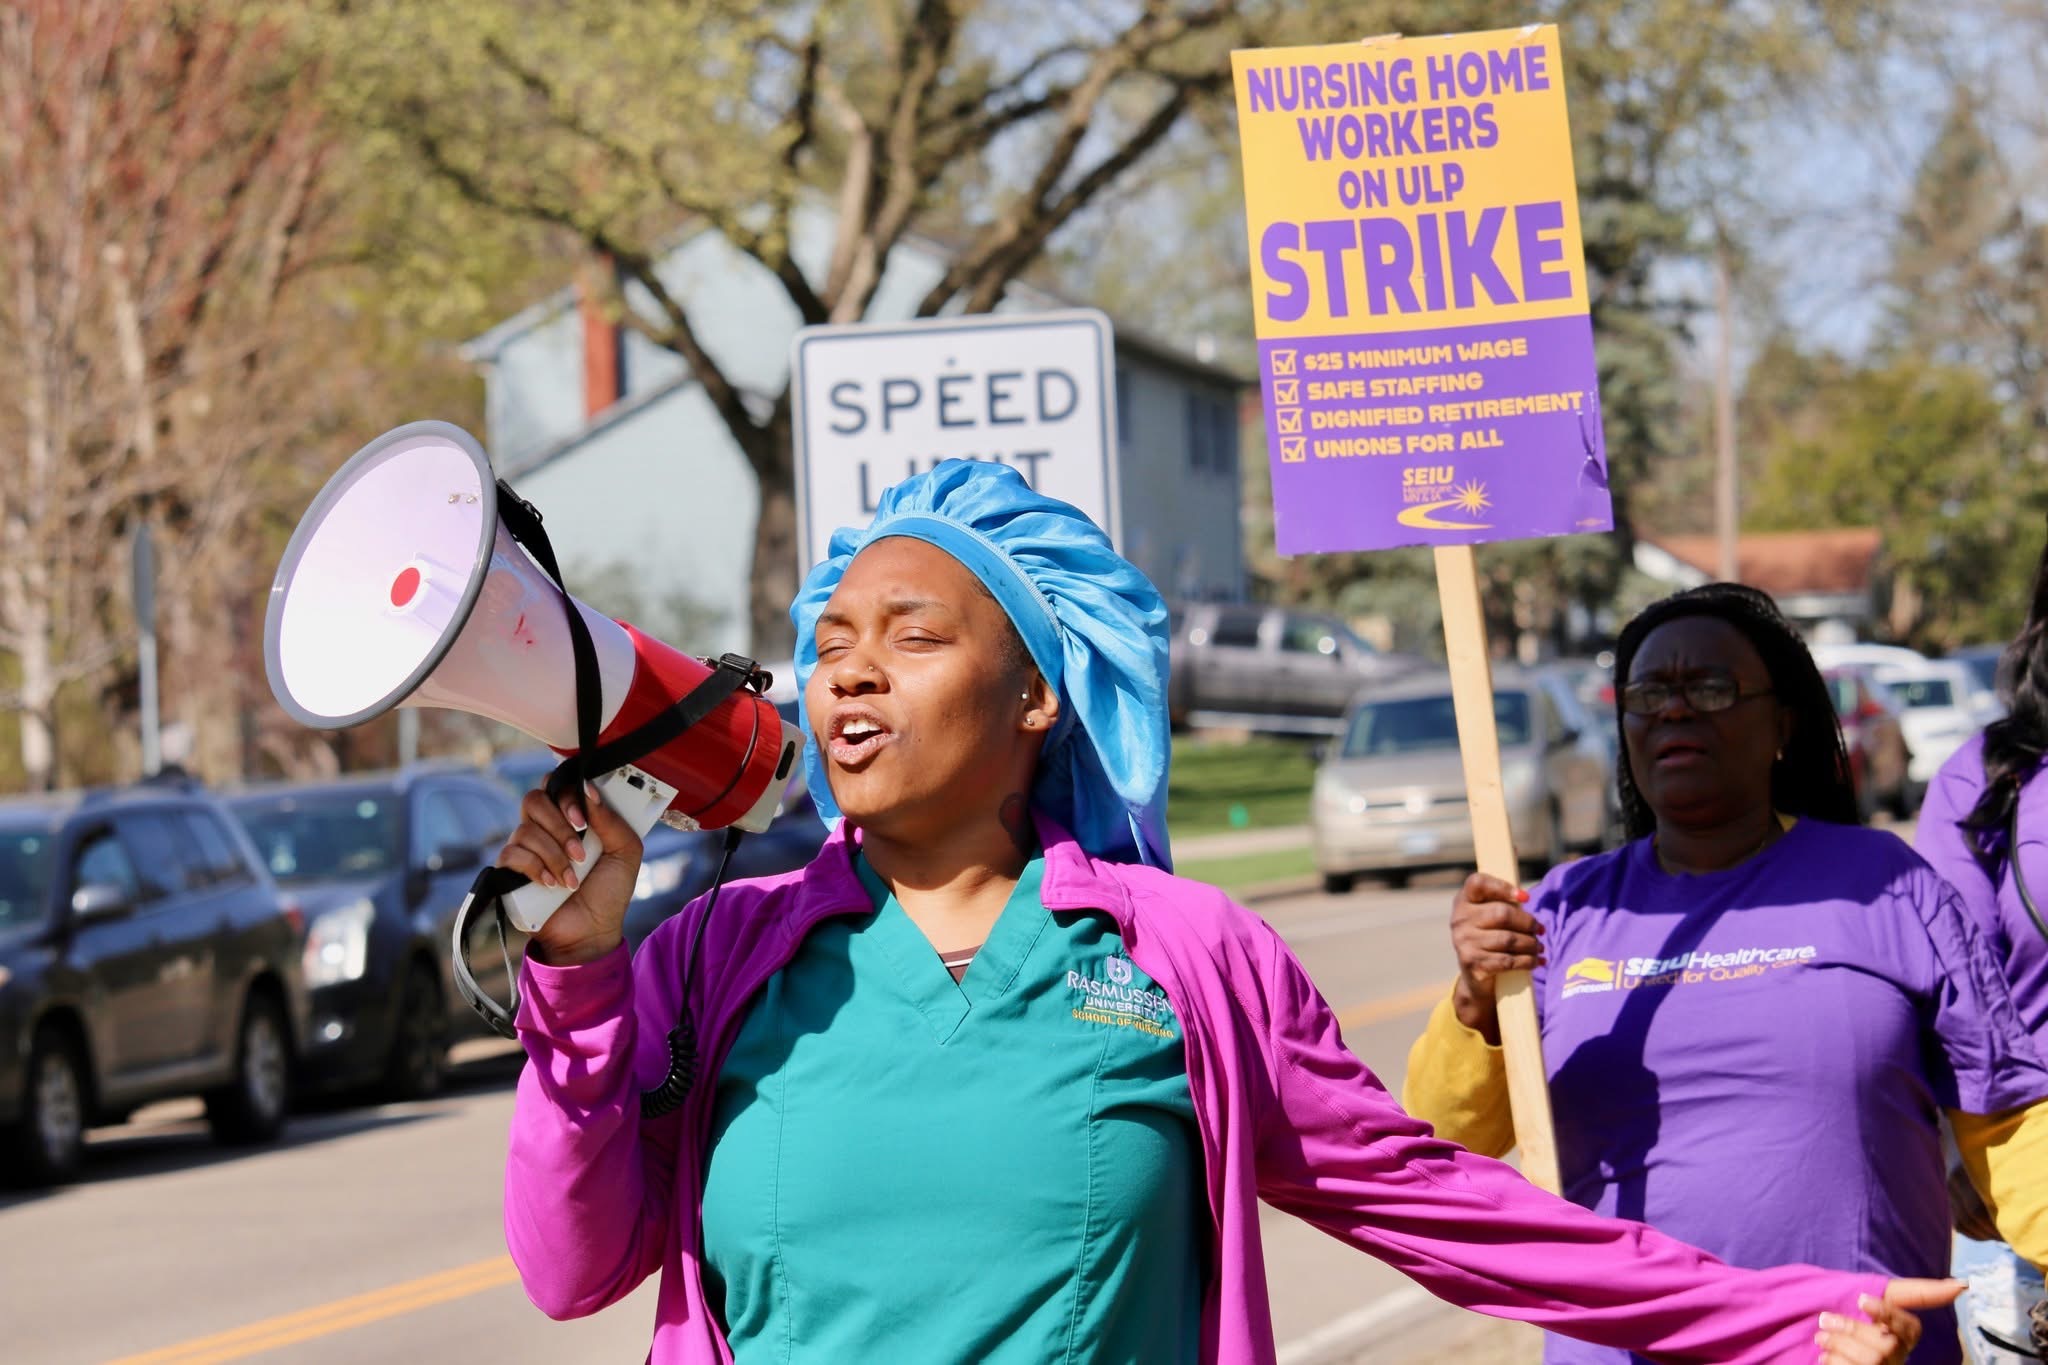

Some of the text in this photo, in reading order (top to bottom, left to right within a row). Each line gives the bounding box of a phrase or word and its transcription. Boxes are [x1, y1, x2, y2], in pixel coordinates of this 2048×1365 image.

[1247, 45, 1550, 113] NURSING HOME
[1296, 102, 1499, 161] WORKERS
[1338, 162, 1464, 210] ON ULP
[1260, 201, 1573, 322] STRIKE
[1303, 338, 1528, 371] $25 MINIMUM WAGE
[829, 367, 1078, 435] SPEED
[1307, 372, 1484, 401] SAFE STAFFING
[1310, 391, 1584, 430] DIGNIFIED RETIREMENT
[1314, 429, 1504, 459] UNIONS FOR ALL
[1402, 465, 1455, 486] SEIU
[1067, 970, 1175, 1013] RASMUSSEN
[1682, 969, 1706, 985] for
[1709, 964, 1766, 982] Quality
[1071, 1008, 1175, 1039] SCHOOL OF NURSING
[1085, 996, 1158, 1020] UNIVERSITY
